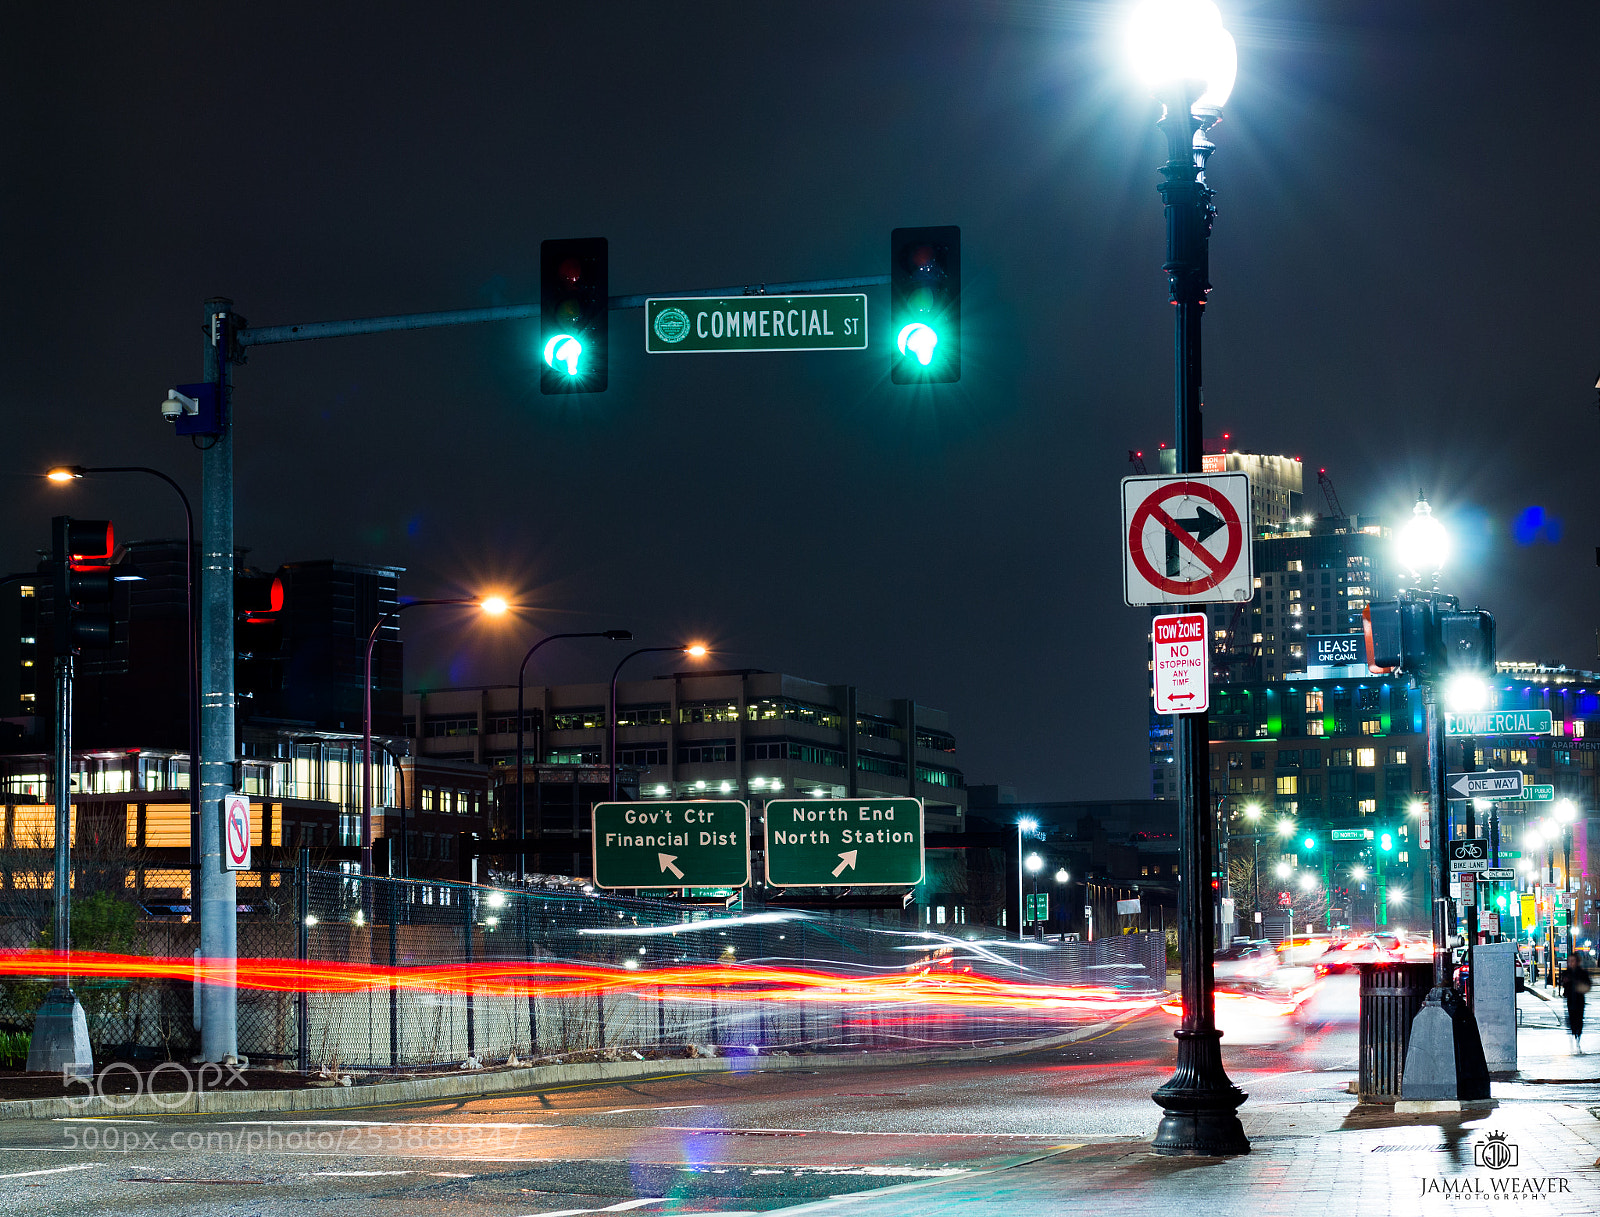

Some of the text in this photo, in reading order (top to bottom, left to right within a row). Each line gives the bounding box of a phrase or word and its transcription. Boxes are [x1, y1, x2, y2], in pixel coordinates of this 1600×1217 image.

[696, 309, 834, 339] COMMERCIAL
[843, 318, 859, 335] ST
[1157, 622, 1202, 640] TOW ZONE
[1170, 645, 1189, 658] NO
[1318, 639, 1357, 653] LEASE
[1159, 658, 1202, 670] STOPPING
[1334, 653, 1358, 661] CANAL
[1172, 670, 1189, 678] ANY
[1447, 714, 1548, 733] COMMERCIAL ST
[1468, 778, 1515, 790] ONE WAY
[1520, 788, 1533, 799] 01
[624, 808, 715, 824] Gov't Ctr
[793, 806, 895, 822] North End
[605, 831, 737, 847] Financial Dist
[774, 829, 914, 845] North Station
